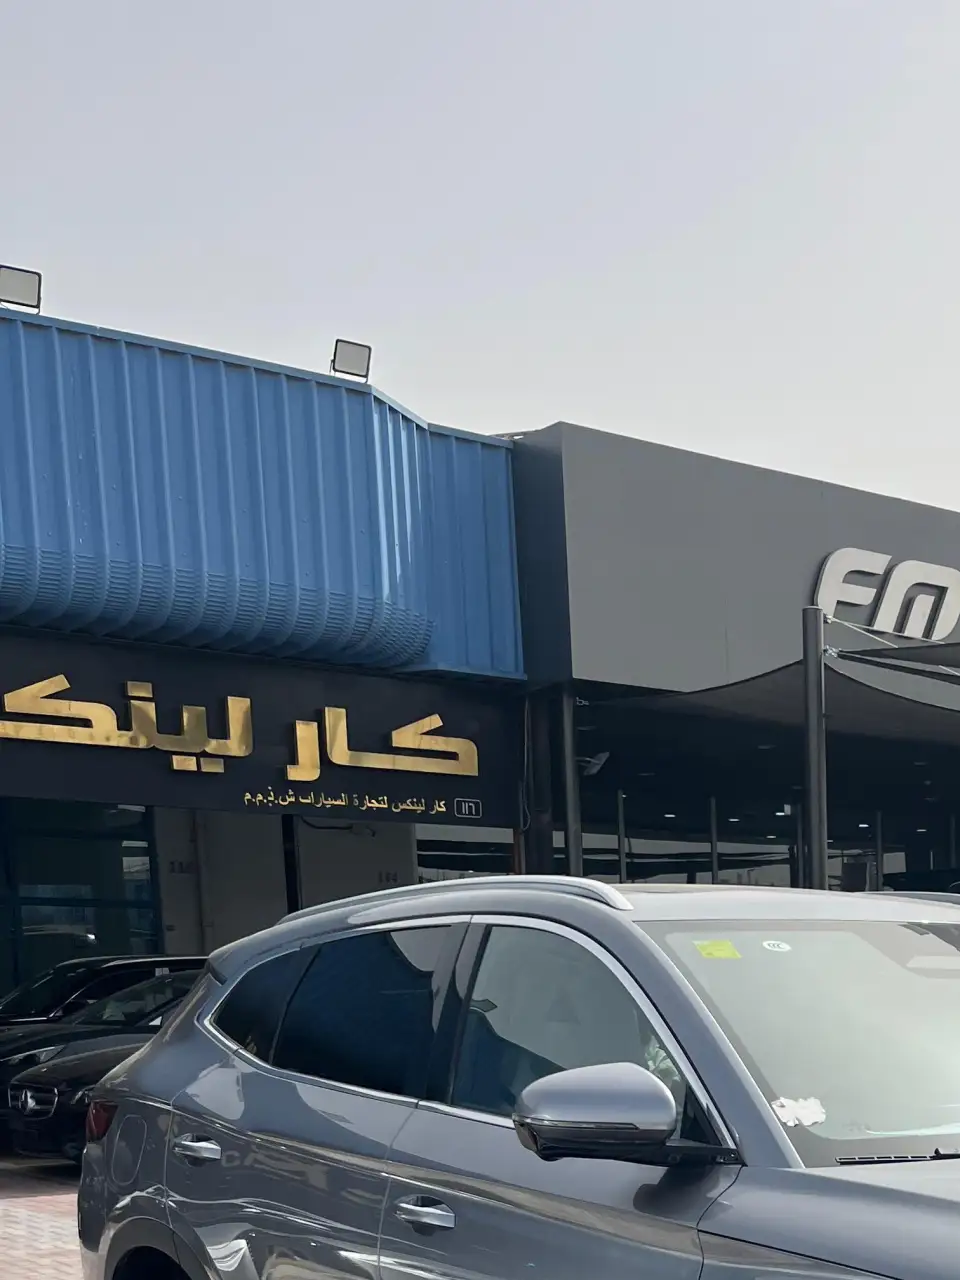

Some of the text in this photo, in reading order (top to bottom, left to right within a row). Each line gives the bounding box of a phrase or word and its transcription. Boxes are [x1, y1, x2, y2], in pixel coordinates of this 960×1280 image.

[0, 674, 479, 782] كار لينك
[353, 793, 388, 811] لتجارة
[391, 798, 426, 813] لينكس
[429, 800, 447, 814] كار
